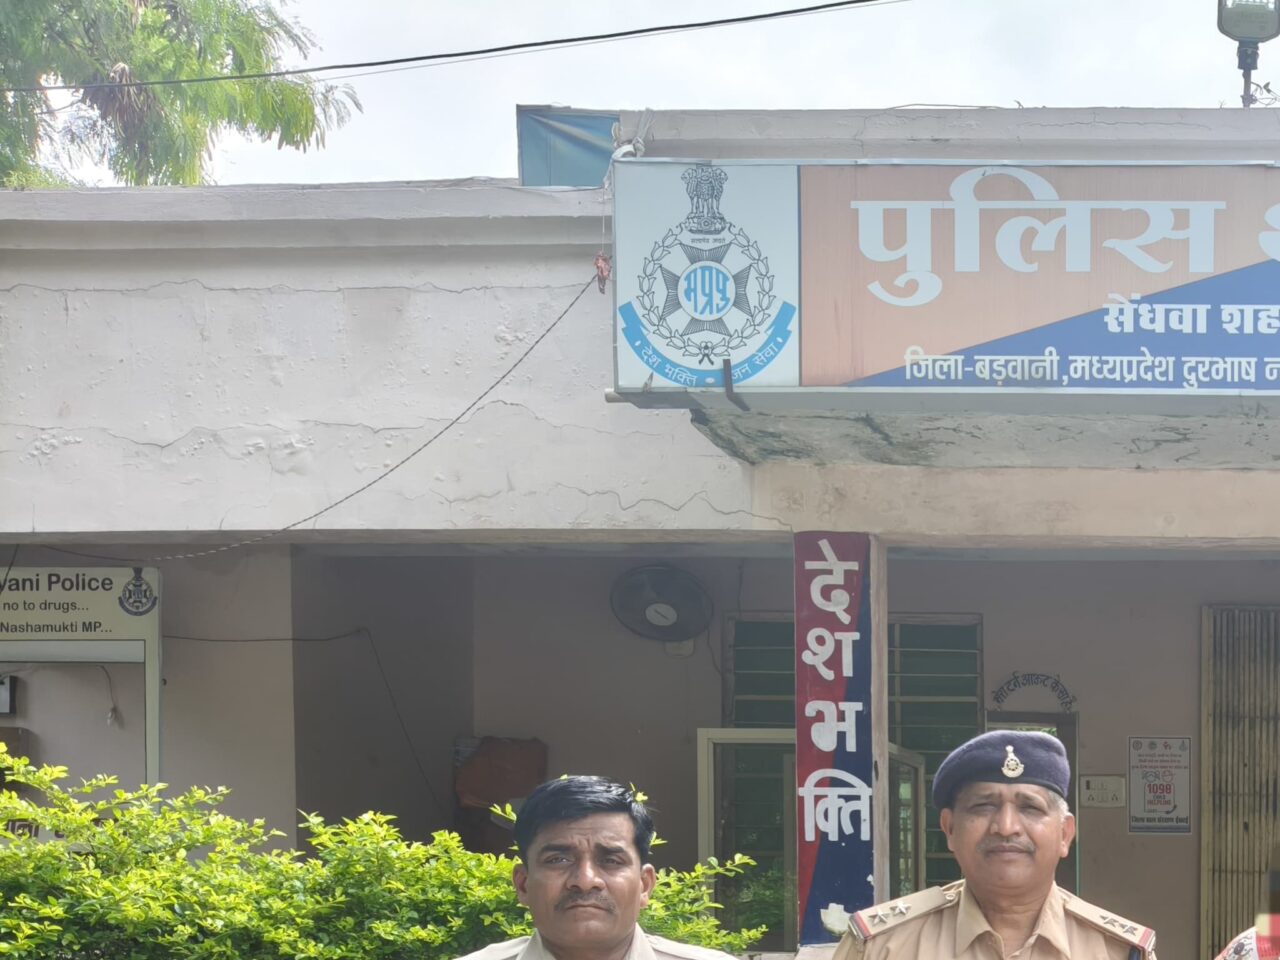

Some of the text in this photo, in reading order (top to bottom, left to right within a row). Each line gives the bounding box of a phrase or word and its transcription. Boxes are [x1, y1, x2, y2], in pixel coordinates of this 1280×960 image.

[851, 166, 1226, 306] पुलिस
[1102, 292, 1212, 334] सेंधवा
[641, 346, 662, 369] देश
[751, 342, 779, 365] सेवा
[47, 572, 114, 592] Police
[3, 600, 89, 614] no to drugs...
[82, 621, 113, 633] MP...
[1146, 783, 1172, 795] 1098
